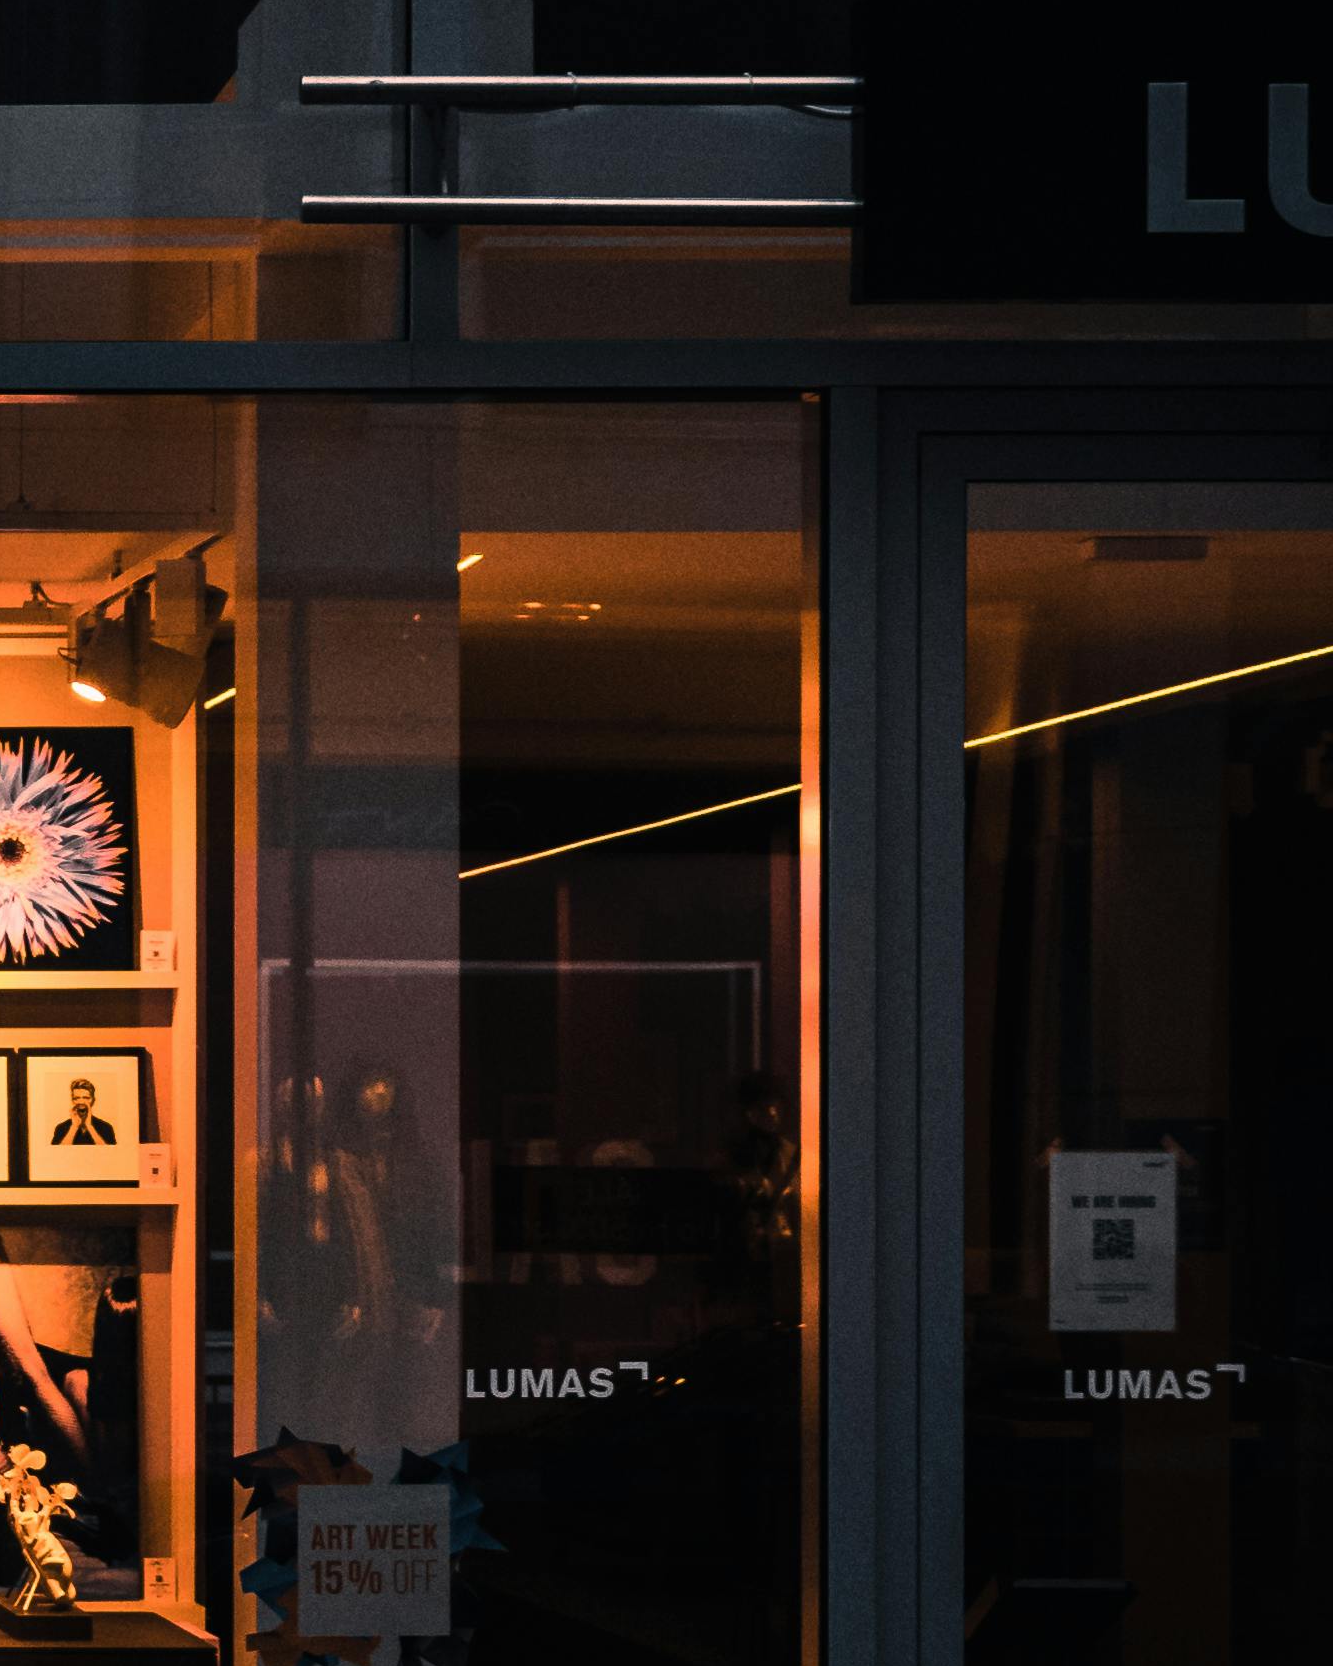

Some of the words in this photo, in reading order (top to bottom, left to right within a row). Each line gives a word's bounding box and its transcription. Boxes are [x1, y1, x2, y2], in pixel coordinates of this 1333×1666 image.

[465, 1366, 615, 1399] LUMAS
[1064, 1368, 1213, 1400] LUMAS
[311, 1523, 357, 1551] ART
[365, 1523, 438, 1551] WEEK
[310, 1558, 383, 1596] 15%
[393, 1558, 438, 1596] OFF
